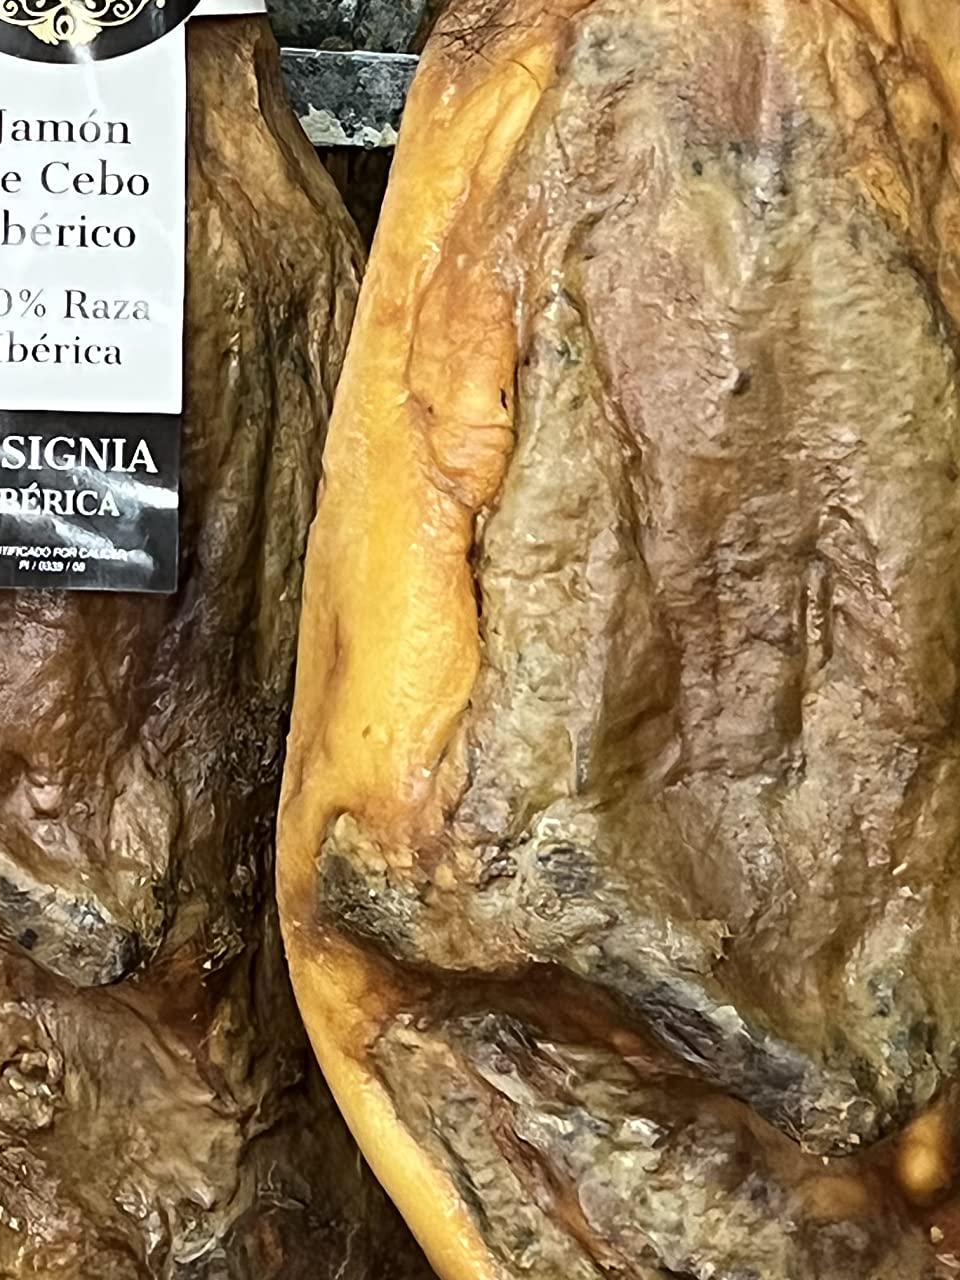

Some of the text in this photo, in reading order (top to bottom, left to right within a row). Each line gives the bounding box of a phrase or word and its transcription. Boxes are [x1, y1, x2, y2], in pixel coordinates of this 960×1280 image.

[40, 158, 150, 196] Cebo
[63, 289, 151, 321] Raza
[53, 547, 78, 559] POR
